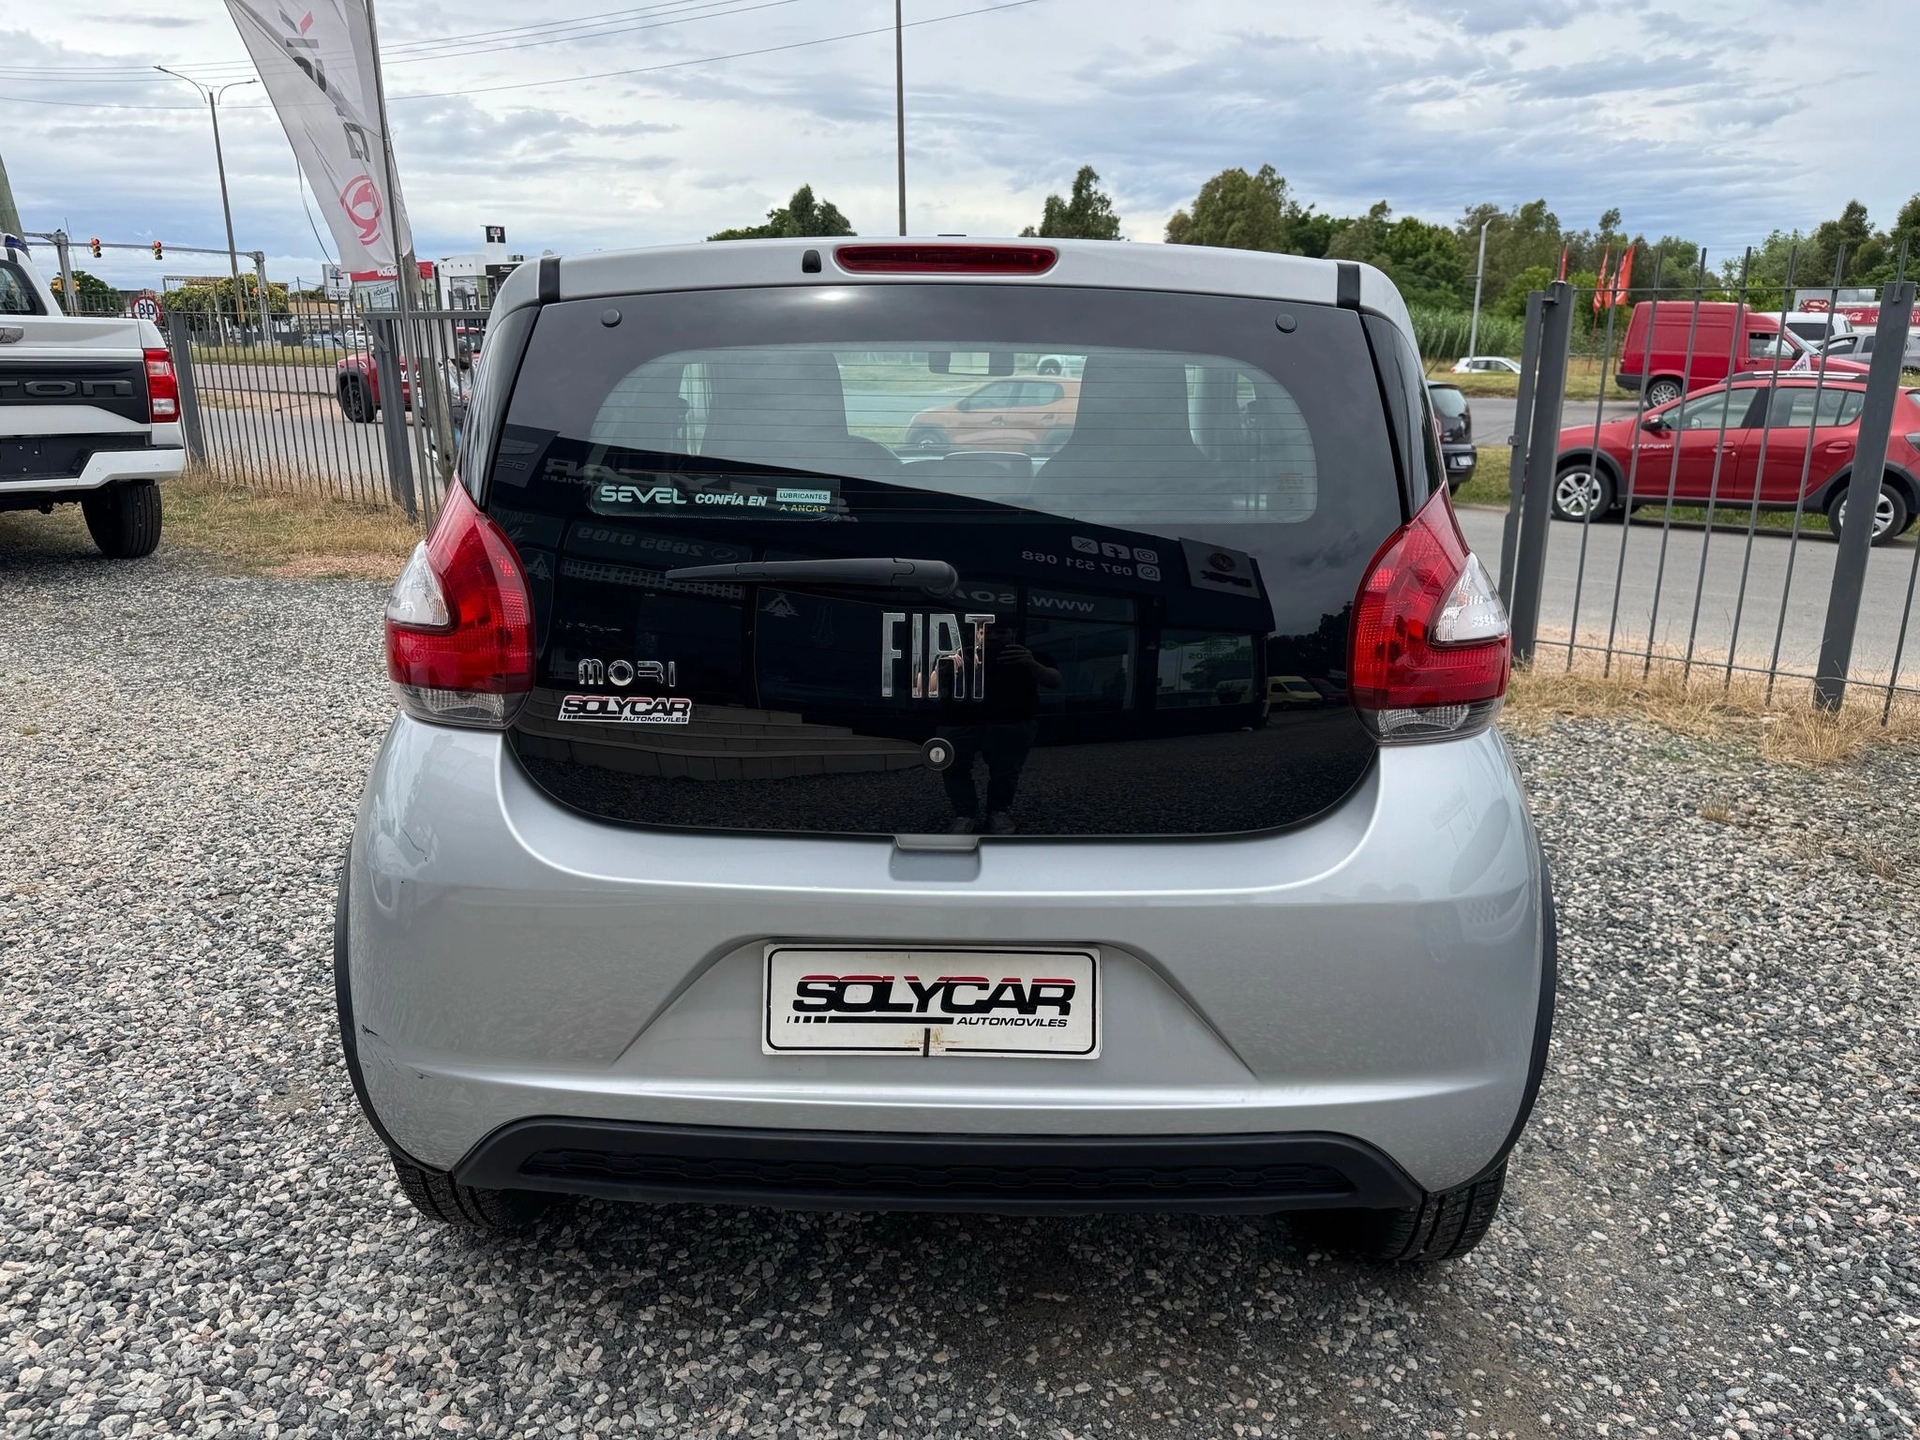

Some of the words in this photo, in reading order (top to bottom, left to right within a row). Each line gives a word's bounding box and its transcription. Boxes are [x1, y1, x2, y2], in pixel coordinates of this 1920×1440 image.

[600, 485, 687, 504] SEVEL
[695, 492, 744, 506] CONFÍA
[747, 496, 767, 507] EN
[779, 492, 828, 501] LUBRICANTES
[790, 504, 827, 513] ANCAP
[881, 612, 996, 699] FIAT
[562, 695, 691, 717] SOLYCAR
[622, 715, 688, 723] AUTOMOVILES
[792, 974, 1077, 1016] SOLYCAR
[956, 1016, 1068, 1028] AUTOMOVILES
